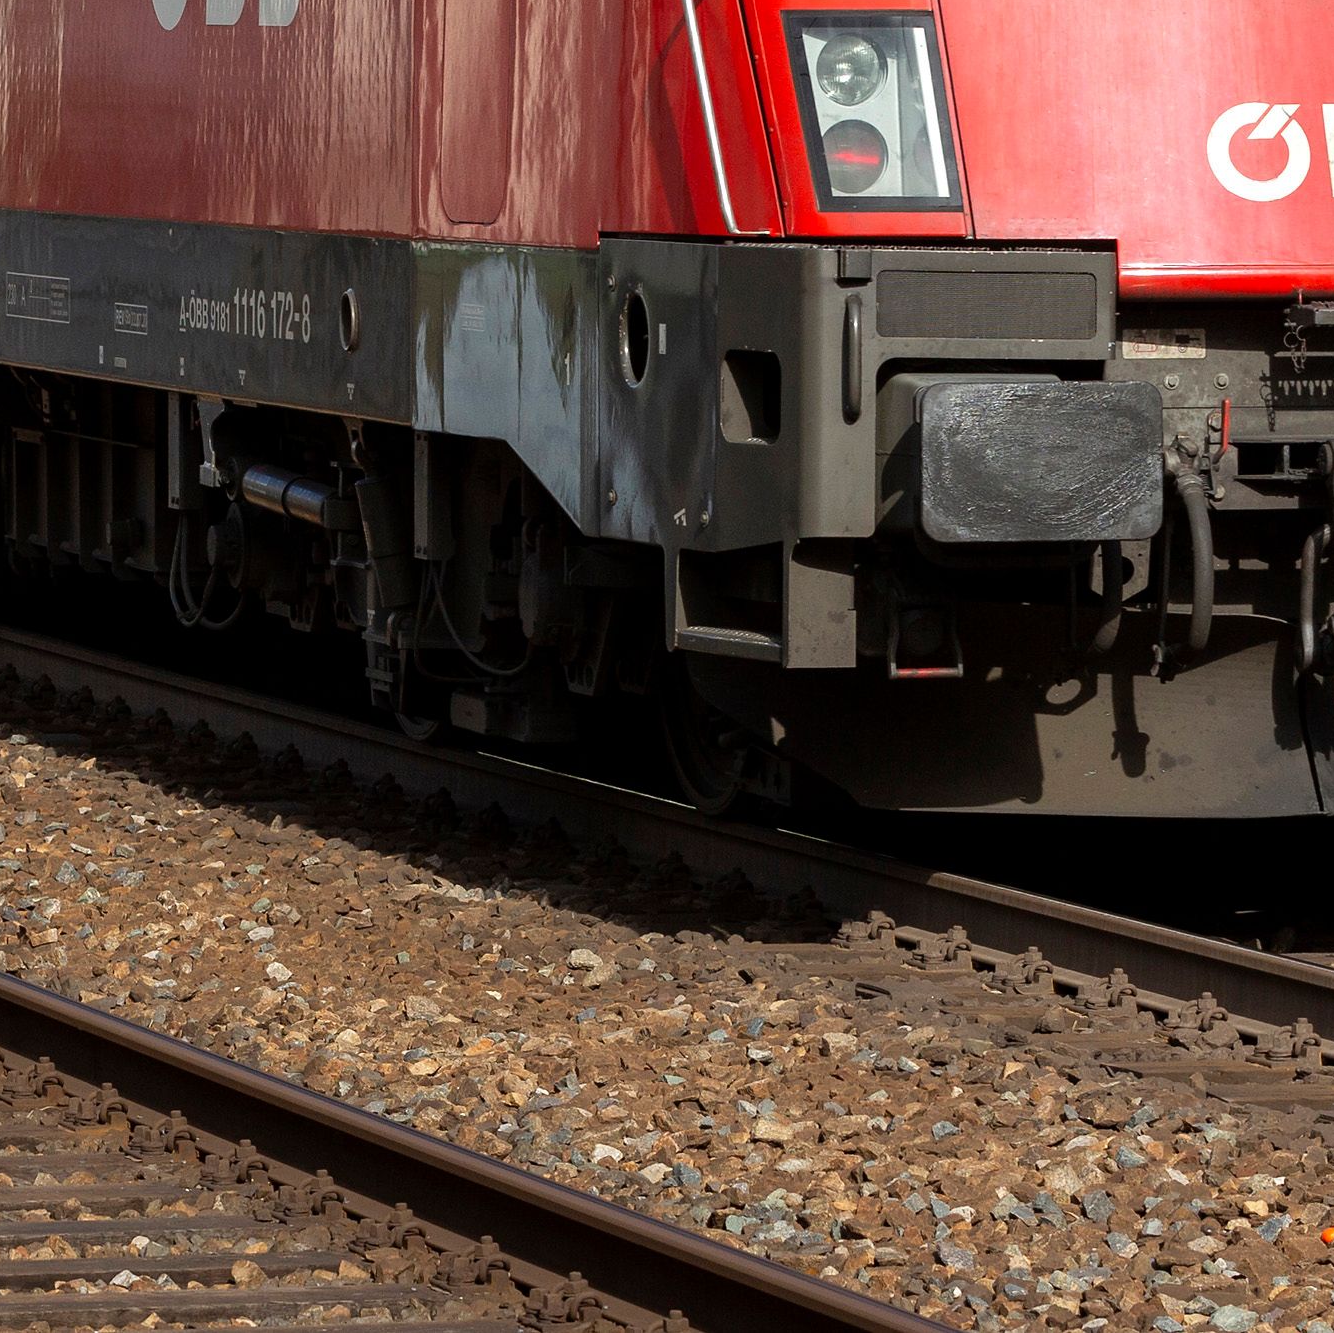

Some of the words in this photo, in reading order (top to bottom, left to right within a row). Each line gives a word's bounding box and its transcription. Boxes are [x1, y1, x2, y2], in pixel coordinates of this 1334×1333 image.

[210, 299, 230, 333] 9181
[233, 287, 266, 339] 1116
[271, 291, 311, 344] 172-8
